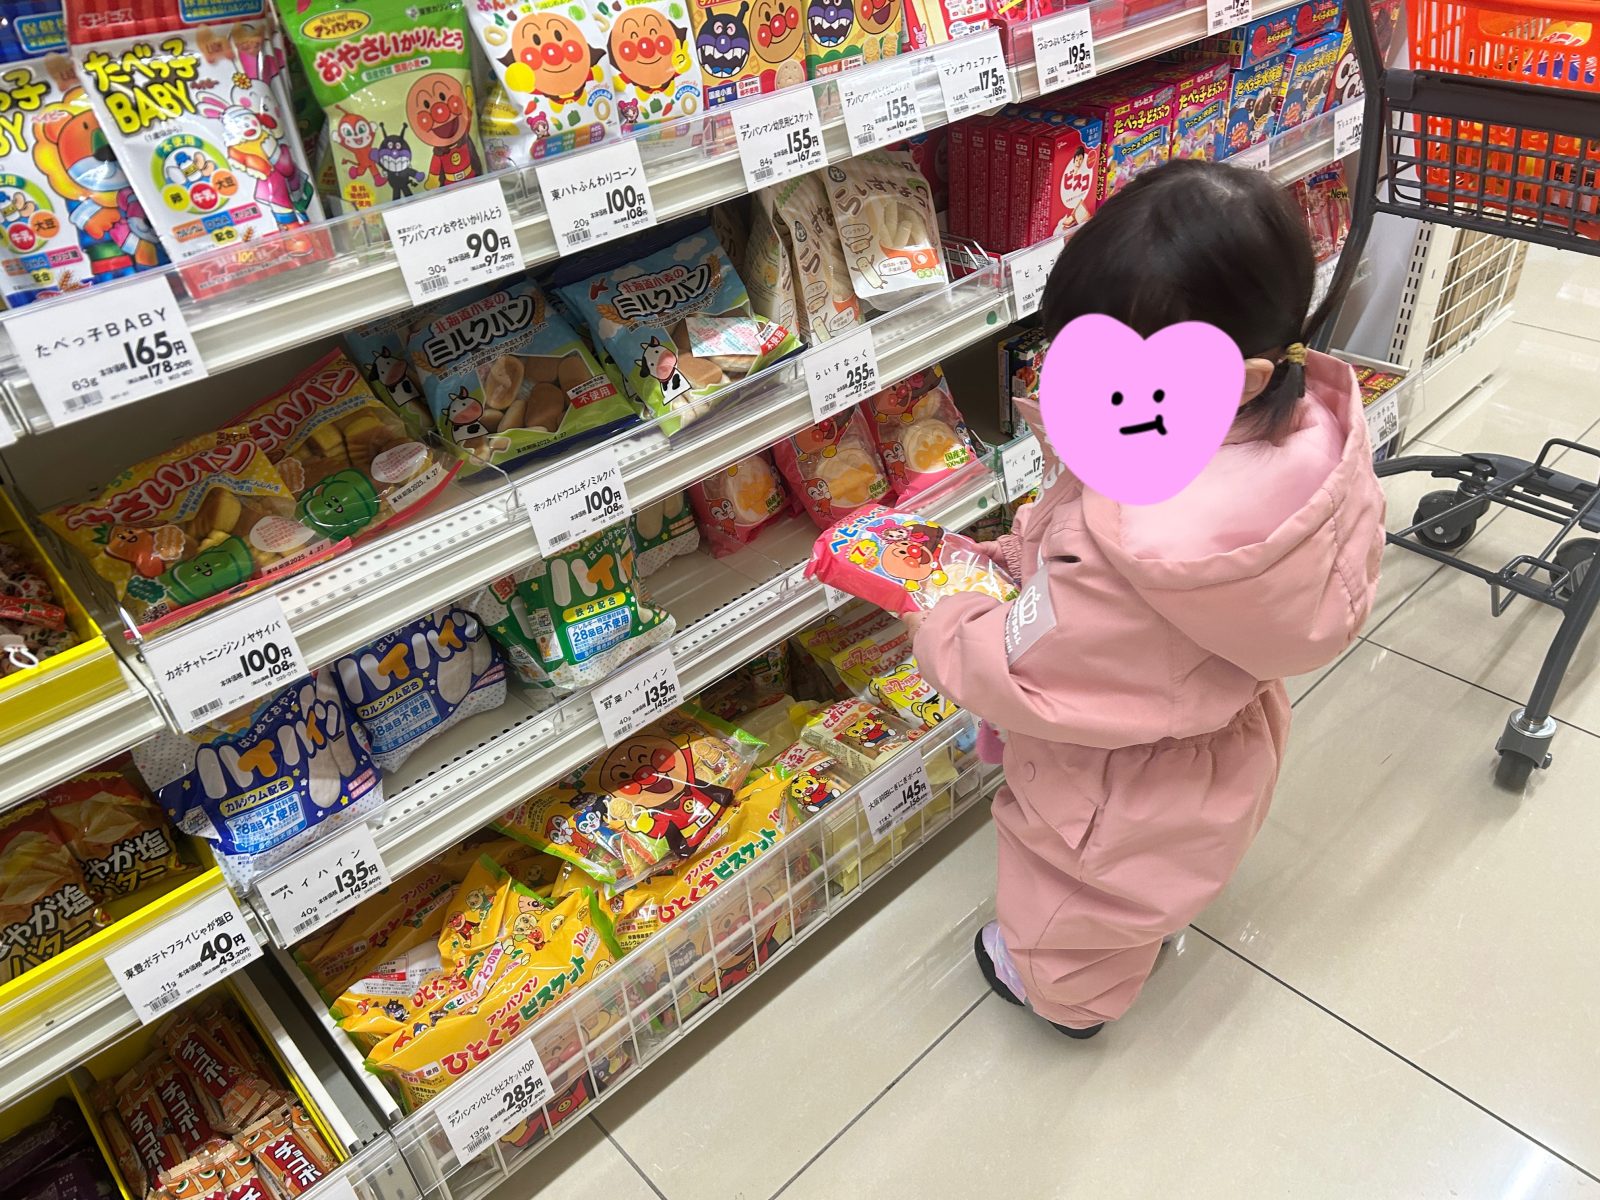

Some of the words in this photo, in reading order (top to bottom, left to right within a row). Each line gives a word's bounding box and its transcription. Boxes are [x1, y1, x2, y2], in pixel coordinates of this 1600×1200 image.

[313, 19, 363, 39] アンパンマン
[1037, 30, 1089, 50] つぶつぶいちごポッキー
[84, 37, 200, 92] たべっ子
[316, 29, 464, 82] おやさいかりんとう
[944, 55, 999, 77] マンナウェファー
[1069, 43, 1091, 66] 195円
[979, 68, 1005, 91] 175円
[104, 79, 197, 136] BABY
[886, 96, 916, 121] 155円
[1133, 95, 1155, 108] ギンビス
[1179, 80, 1229, 111] たべっ子どうぶつ
[741, 111, 814, 141] アンパンマン幼児用ビスケット
[1113, 105, 1171, 137] たべっ子どうぶつ
[161, 136, 200, 155] 不使用
[787, 128, 820, 154] 155円
[759, 158, 773, 167] 84g
[216, 176, 237, 190] 大豆
[550, 167, 637, 201] 東ハトふんわりコーン
[1063, 168, 1090, 192] ビスコ
[1330, 189, 1347, 199] New
[193, 188, 218, 203] 牛乳
[606, 185, 646, 215] 100円
[33, 216, 56, 231] 大豆
[207, 215, 230, 230] DHA
[233, 206, 260, 221] オリゴ糖
[399, 207, 502, 247] アンパンマンおやさいかりんとう
[573, 219, 590, 230] 20g
[626, 207, 648, 221] 108円
[11, 228, 34, 244] 牛乳
[215, 229, 236, 241] 配合
[447, 252, 471, 265] 本体価格
[466, 228, 511, 259] 90円
[33, 271, 51, 283] 配合
[428, 264, 447, 276] 30g
[484, 252, 514, 267] 97.20円
[1024, 259, 1056, 279] ビスコ
[617, 265, 711, 318] ミルクパン
[620, 267, 684, 294] 北海道小麦の
[434, 293, 507, 335] 北海道小麦の
[34, 307, 168, 359] たべっ子BABY
[426, 297, 534, 363] ミルクパン
[763, 328, 788, 355] 不使用
[99, 361, 128, 377] 本体価格
[123, 331, 187, 370] 165円
[816, 349, 868, 381] らいすなっく
[71, 376, 99, 391] 63g
[846, 362, 875, 389] 255円
[579, 387, 612, 405] 不使用
[824, 393, 837, 402] 20g
[944, 447, 967, 462] 国産米
[66, 440, 257, 531] やさいパン
[533, 467, 616, 513] ホッカイドウコムギノミルクパ
[570, 510, 588, 521] 本体価格
[584, 486, 622, 515] 100円
[603, 501, 625, 517] 108円
[574, 597, 618, 617] 鉄分配合
[573, 616, 630, 643] 28品目不使用
[165, 621, 282, 681] カボチャトニンジンノヤサイパ
[220, 672, 244, 688] 本体価格
[240, 642, 293, 678] 100円
[267, 662, 297, 678] 108円
[361, 681, 421, 718] カルシウム配合
[603, 666, 668, 711] 野菜ハイハイン
[644, 680, 676, 708] 135円
[903, 683, 931, 701] しまじ
[239, 685, 299, 749] はじめておやつ
[618, 716, 632, 726] 40g
[196, 699, 345, 800] ハイハイン
[225, 780, 290, 813] カルシウム配合
[901, 780, 927, 805] 145円
[282, 849, 361, 899] ハイハイン
[657, 828, 778, 924] ひとくちビスケット
[684, 846, 731, 885] アンパンマン
[317, 889, 339, 905] 本体価格
[334, 861, 379, 893] 135円
[401, 873, 442, 903] アンパンマン
[300, 905, 318, 919] 40g
[123, 911, 234, 981] 東豊ポテトフライじゃが塩B
[176, 961, 203, 980] 本体価格
[199, 932, 247, 965] 40円
[160, 980, 178, 993] 11g
[218, 945, 250, 967] 43.20円
[486, 976, 539, 1026] アンパンマン
[441, 955, 587, 1077] ひとくちビスケット
[180, 1038, 229, 1089] チョコボー
[449, 1060, 536, 1129] アンパンマンひとくちビスケット10P
[489, 1108, 507, 1123] 本体価格
[502, 1076, 544, 1113] 285円
[161, 1081, 202, 1142] チョコボー
[469, 1124, 490, 1141] 135g
